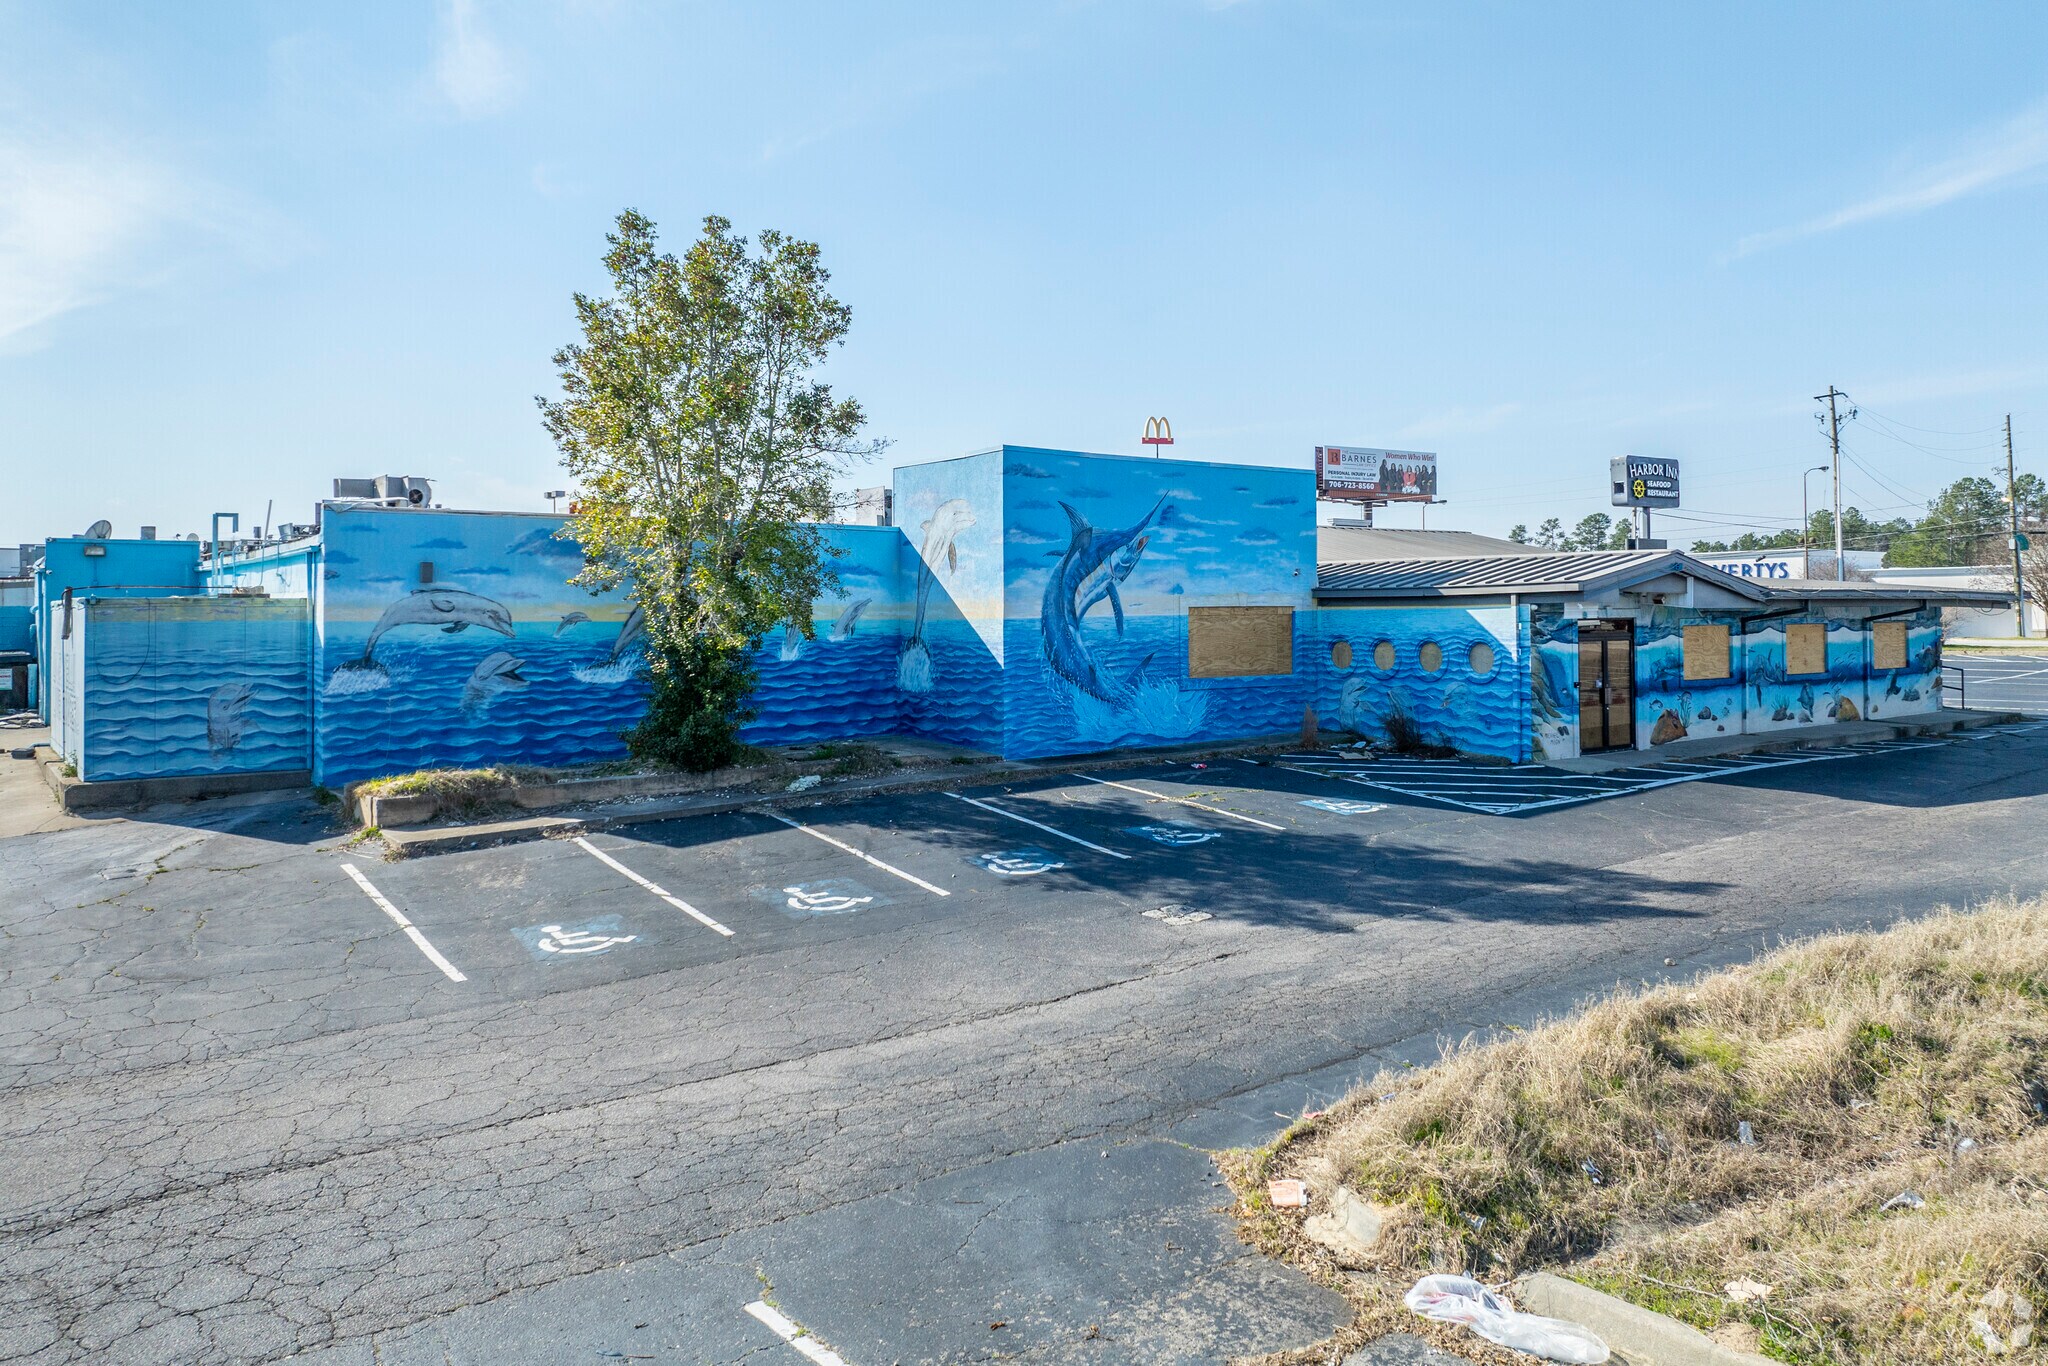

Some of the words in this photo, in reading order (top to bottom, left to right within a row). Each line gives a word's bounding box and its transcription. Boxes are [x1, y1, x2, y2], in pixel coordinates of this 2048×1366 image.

[1342, 454, 1377, 464] BARNES
[1385, 452, 1407, 460] Women
[1630, 463, 1664, 478] HARBOR
[1329, 481, 1375, 490] 706-723-8560
[1647, 490, 1679, 498] RESTAURANT
